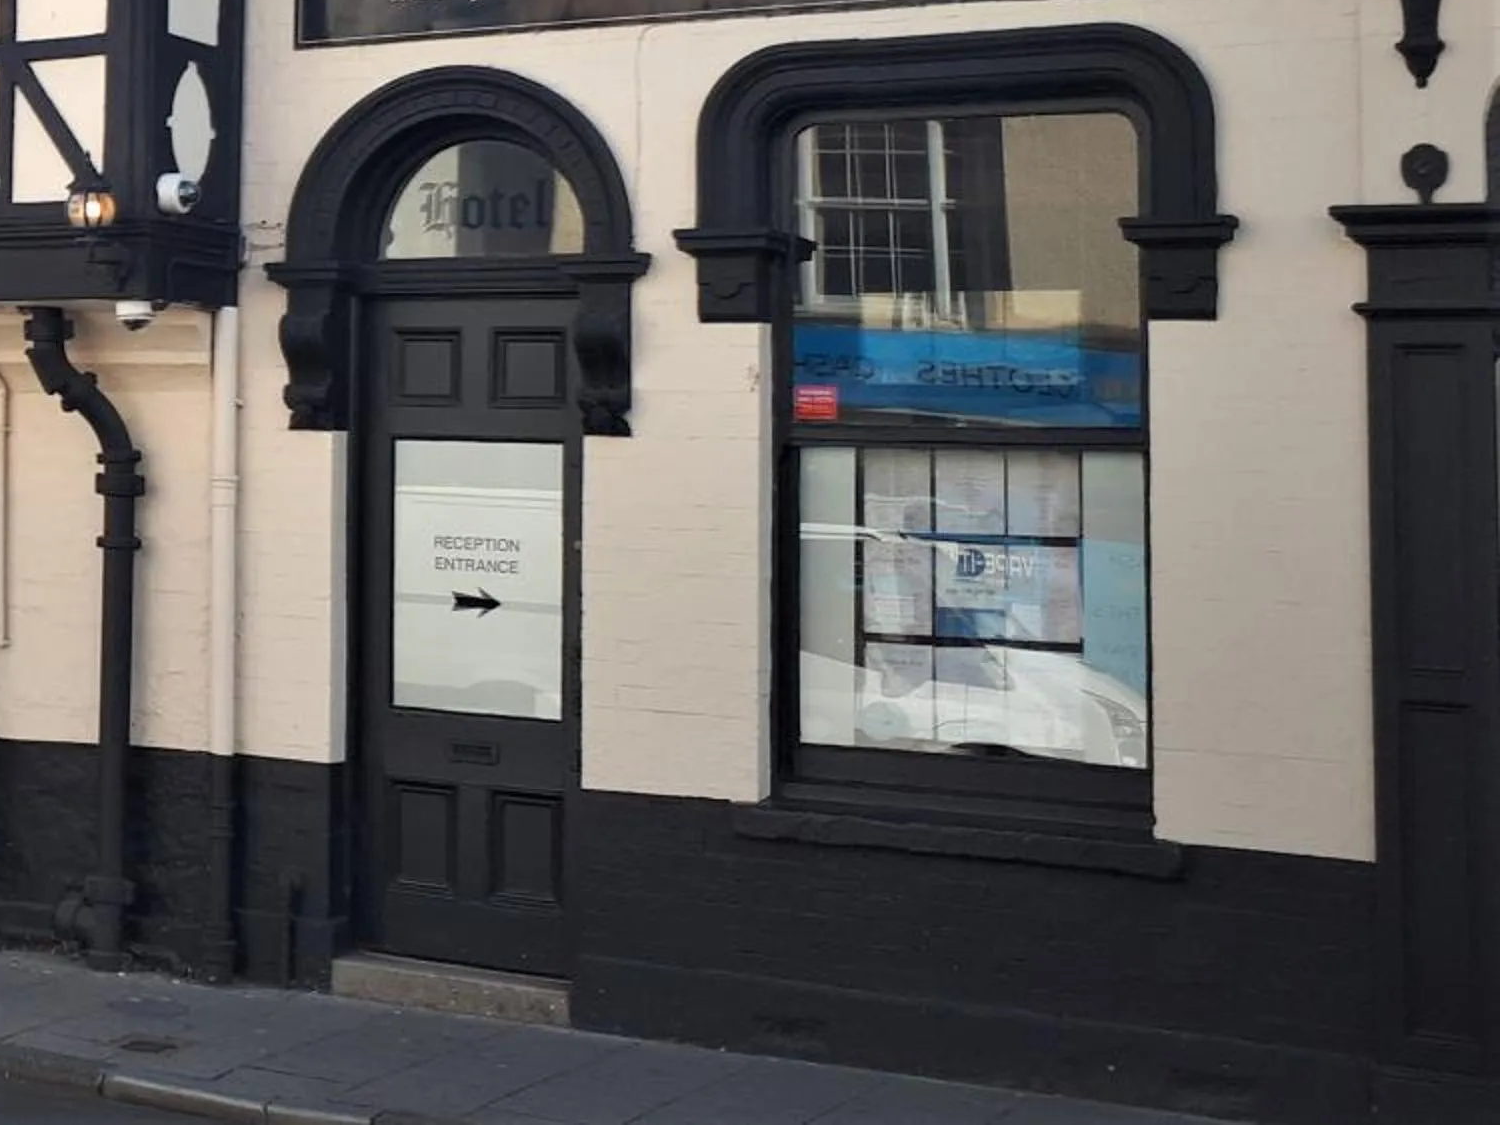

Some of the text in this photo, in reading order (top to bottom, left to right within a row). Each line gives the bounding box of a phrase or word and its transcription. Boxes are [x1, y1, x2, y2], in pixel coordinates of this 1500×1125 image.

[419, 179, 553, 239] Hotel
[434, 536, 520, 552] RECEPTION
[434, 556, 519, 574] ENTRANCE
